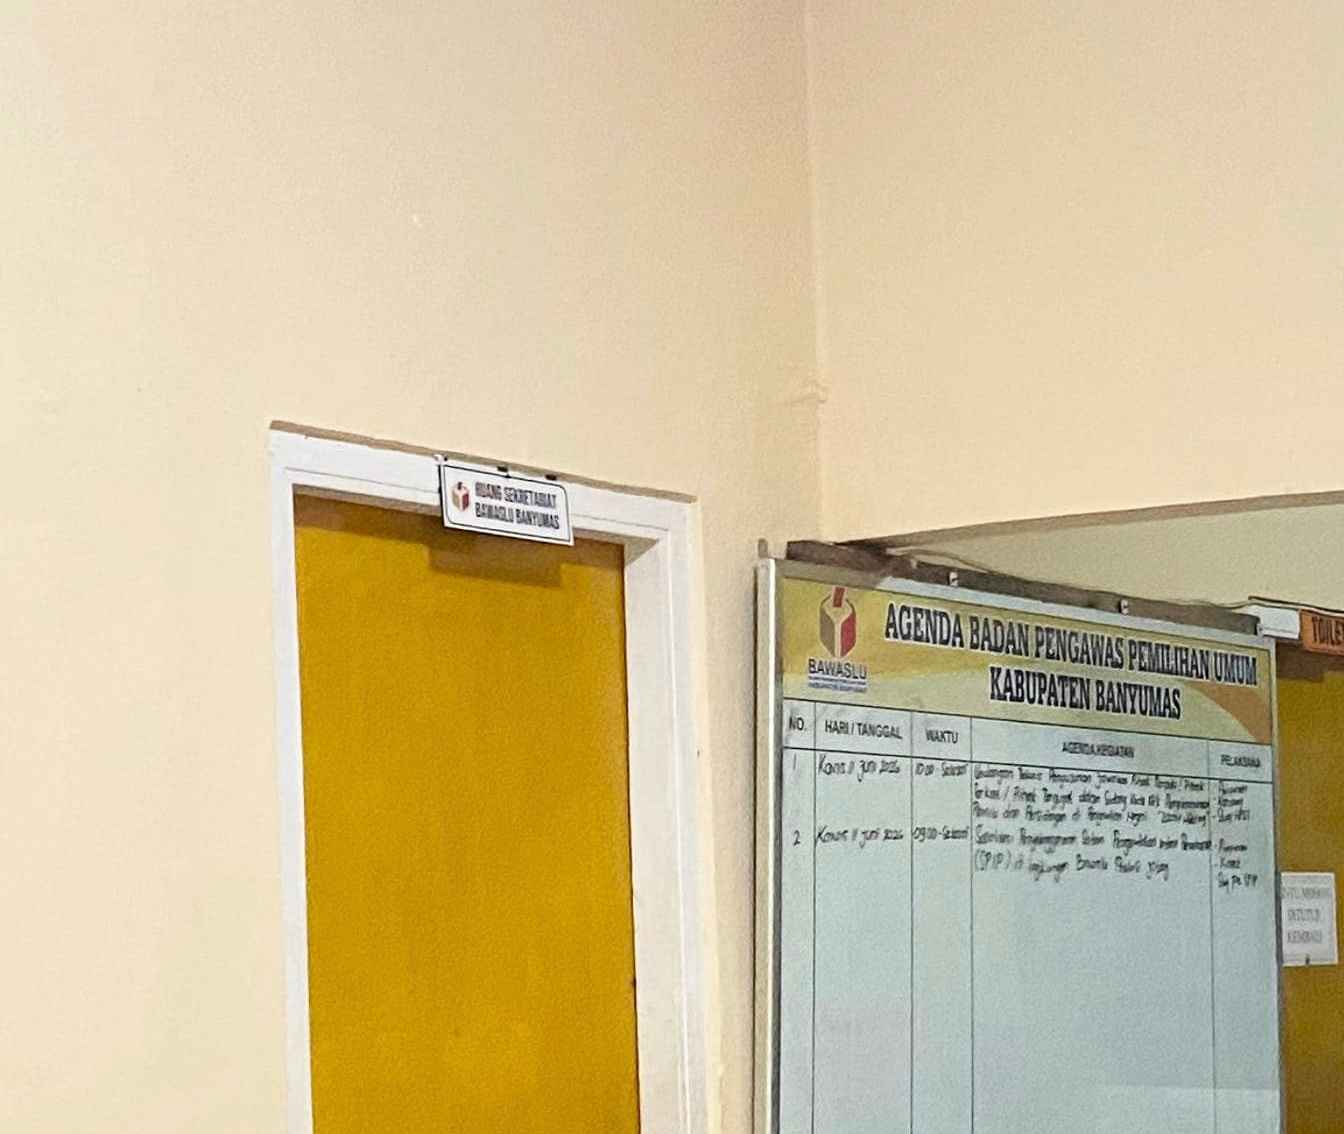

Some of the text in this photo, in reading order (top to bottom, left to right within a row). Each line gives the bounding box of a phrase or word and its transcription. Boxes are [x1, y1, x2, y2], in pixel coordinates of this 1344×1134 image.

[475, 481, 557, 508] RUANG SEKRETARIAT
[475, 502, 560, 530] BAWASLU BANYUMAS
[885, 602, 1258, 686] AGENDA BADAN PENGAWAS PEMILIHAN UMUM
[808, 657, 868, 680] BAWASLU
[990, 666, 1181, 721] KABUPATEN BANYUMAS
[825, 719, 849, 735] HARI
[857, 722, 903, 740] TANGGAL
[925, 728, 959, 744] WAKTU
[793, 830, 801, 846] 2
